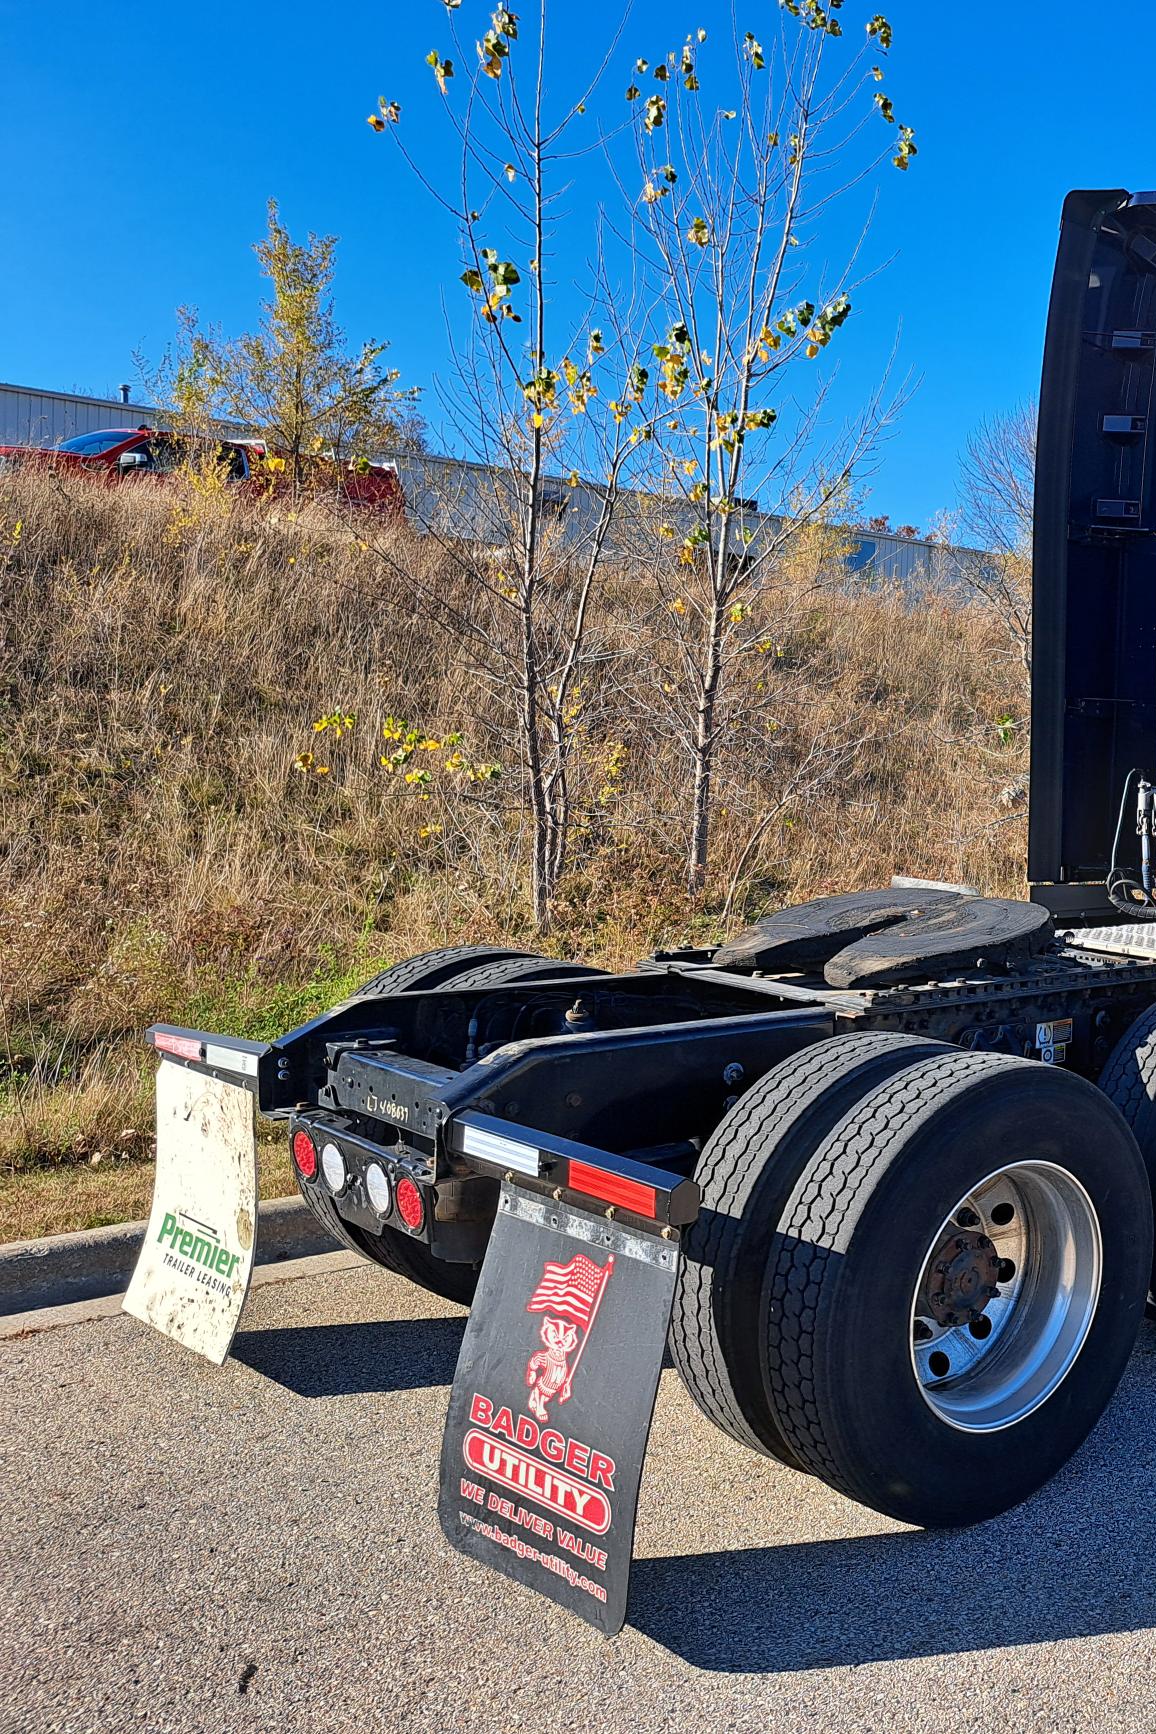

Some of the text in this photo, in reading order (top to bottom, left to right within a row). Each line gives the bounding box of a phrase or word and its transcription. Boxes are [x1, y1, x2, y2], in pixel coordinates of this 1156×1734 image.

[156, 1211, 241, 1279] Premier
[162, 1253, 232, 1297] TRAILER LEASING
[469, 1392, 616, 1492] BADGER
[481, 1442, 592, 1517] UTILITY
[458, 1510, 608, 1604] www.badger-utility.com
[460, 1478, 609, 1571] WE DELIVER VALUE
